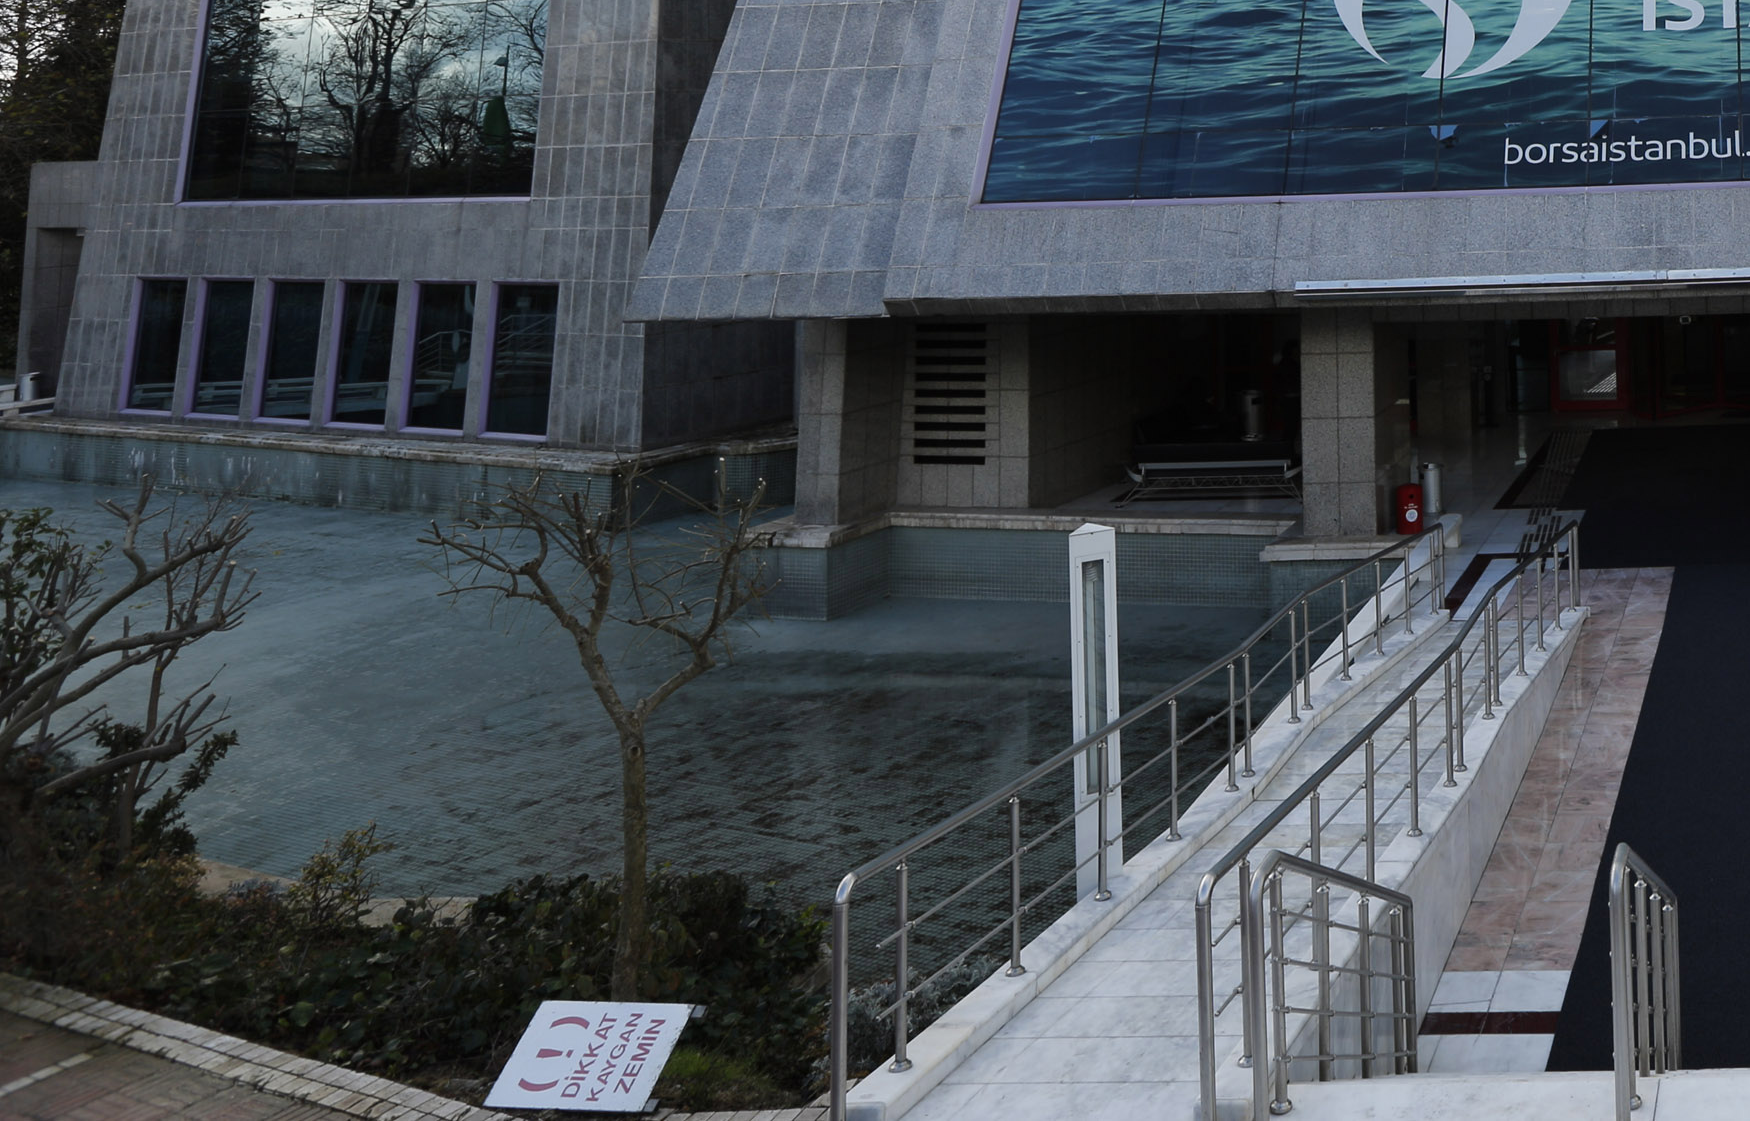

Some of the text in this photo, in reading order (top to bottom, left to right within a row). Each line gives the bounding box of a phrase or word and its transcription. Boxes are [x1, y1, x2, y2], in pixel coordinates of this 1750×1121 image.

[560, 1012, 618, 1098] DİKKAT
[585, 1013, 644, 1102] KAYGAN
[613, 1019, 667, 1094] ZEMİN
